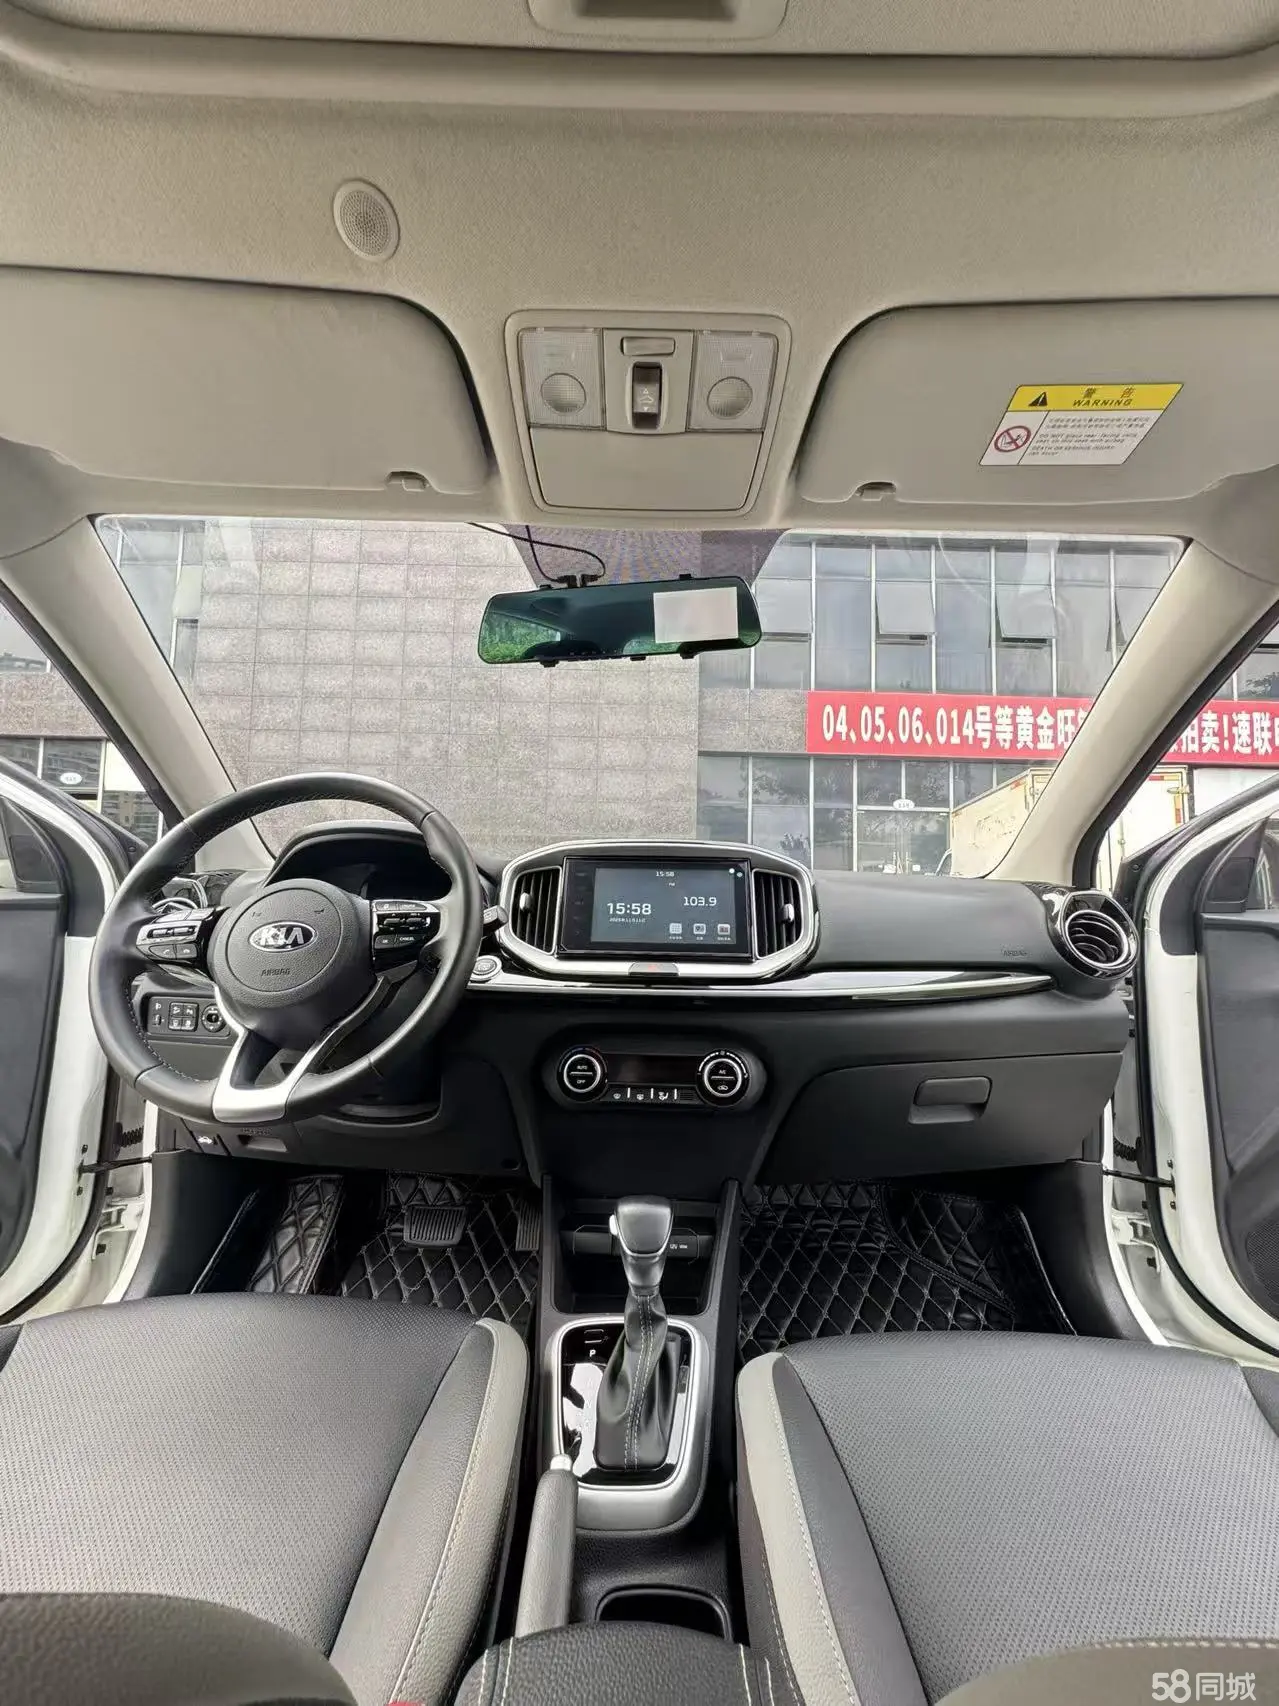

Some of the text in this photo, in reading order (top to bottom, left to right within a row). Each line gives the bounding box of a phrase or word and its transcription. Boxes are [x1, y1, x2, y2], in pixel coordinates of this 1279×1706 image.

[1072, 399, 1133, 407] WARNING
[822, 704, 1091, 751] 04、05、06、014号等黄金旺
[683, 896, 717, 907] 103.9
[607, 902, 652, 915] 15:58
[259, 927, 305, 946] KIA
[261, 967, 291, 976] AIRBAG
[589, 1349, 596, 1357] P
